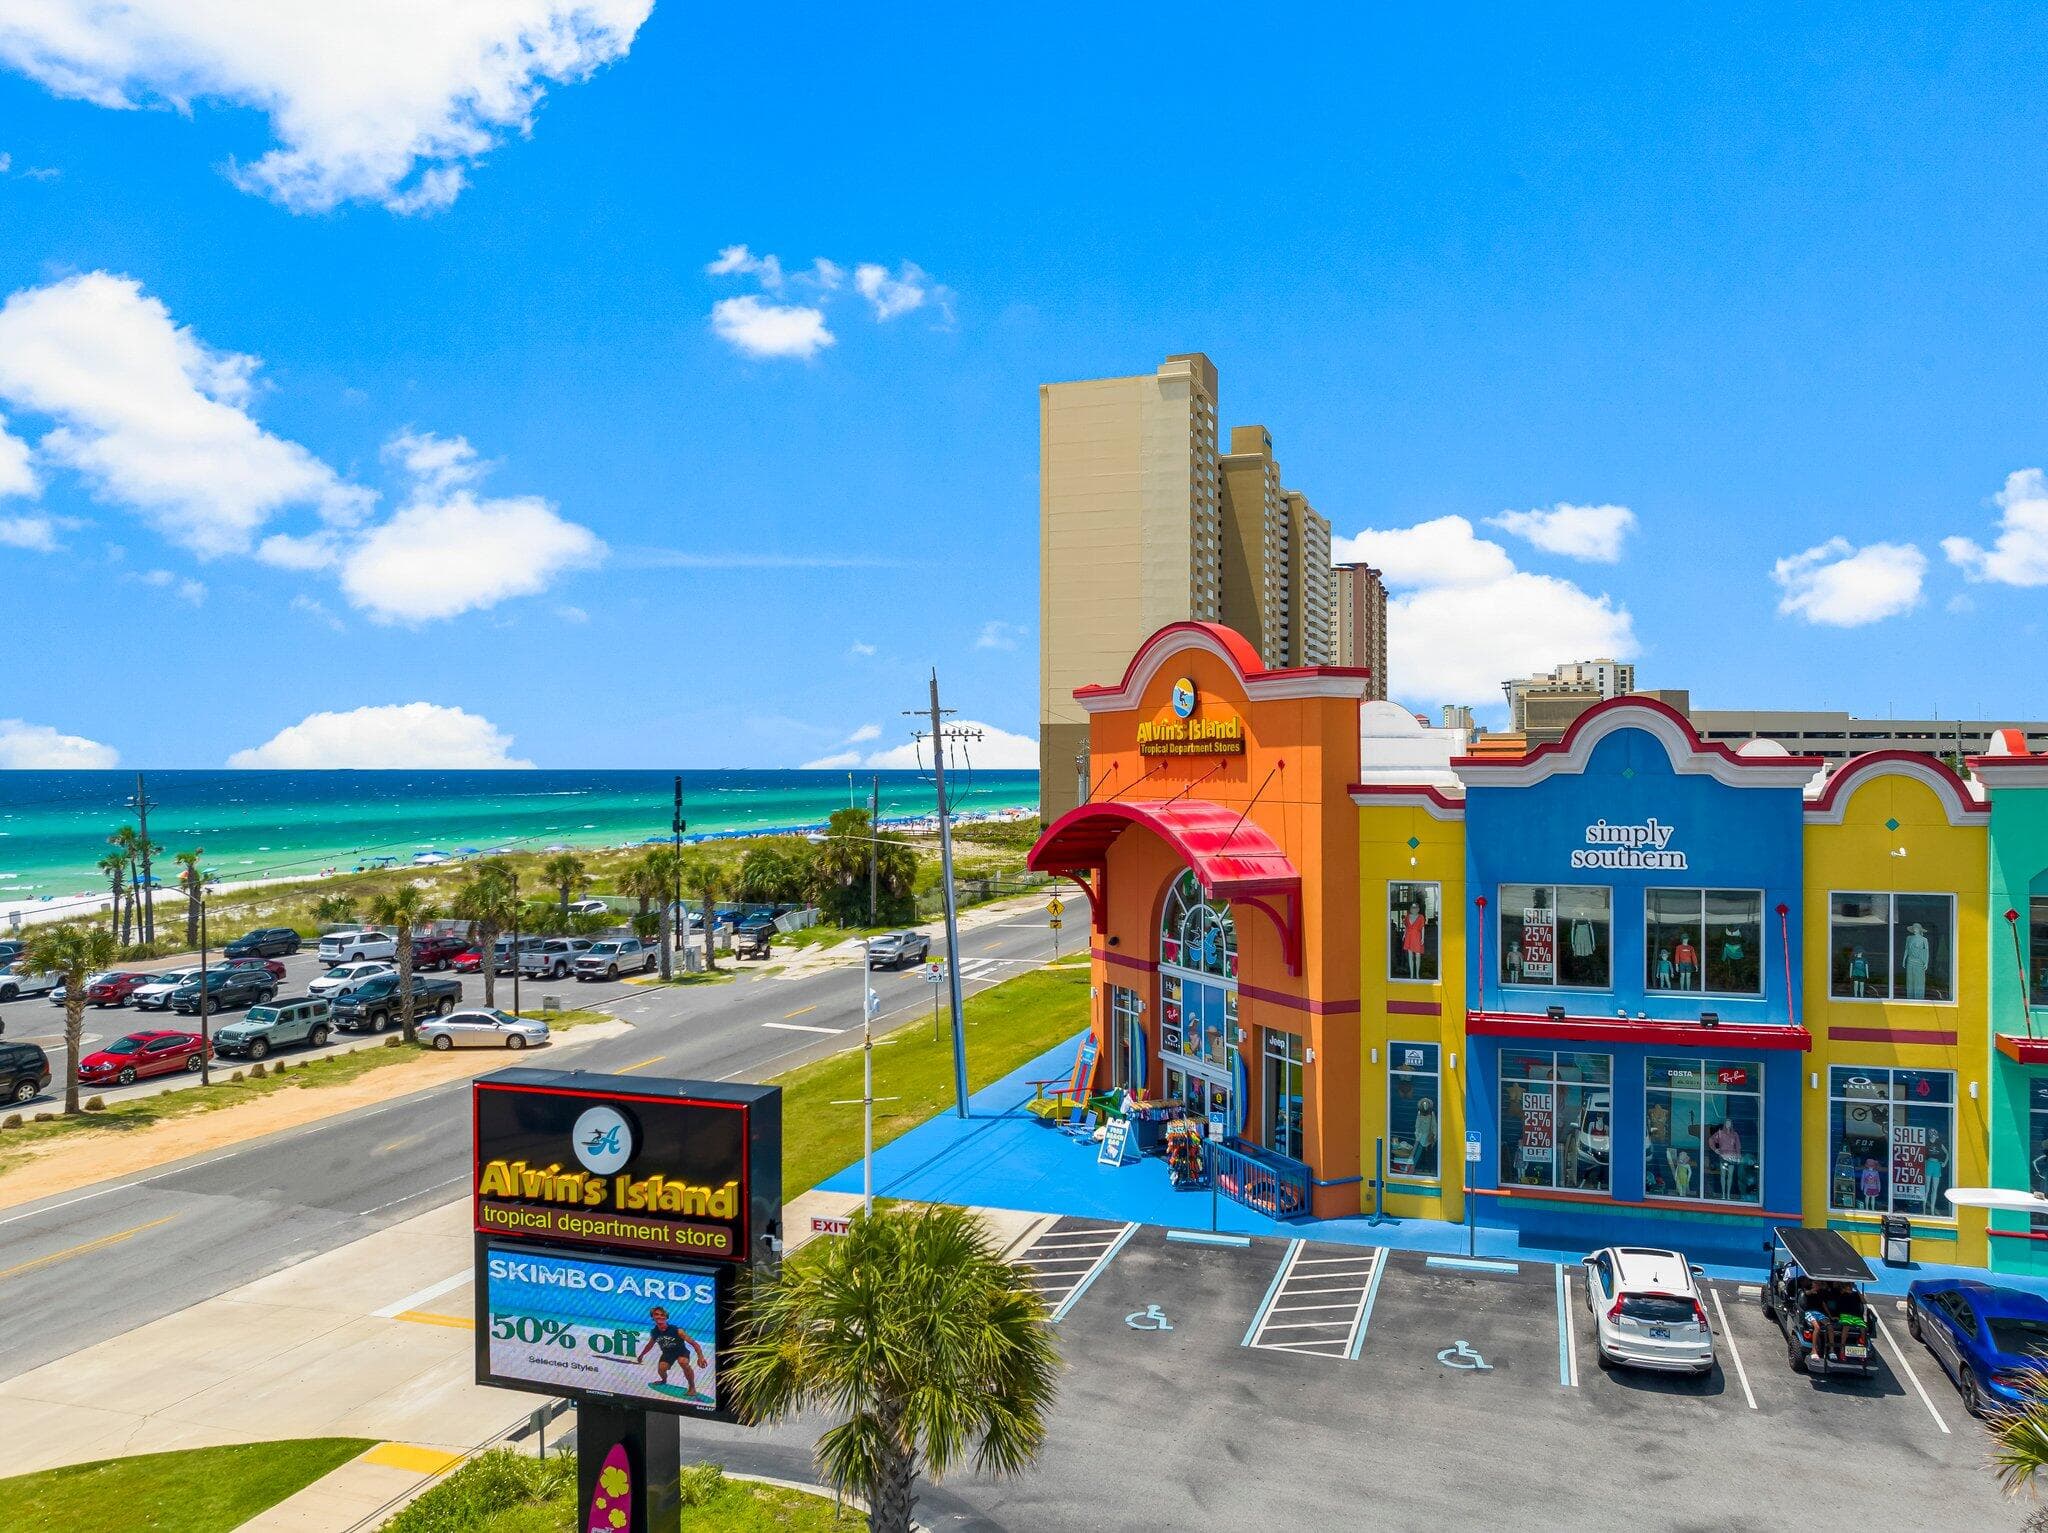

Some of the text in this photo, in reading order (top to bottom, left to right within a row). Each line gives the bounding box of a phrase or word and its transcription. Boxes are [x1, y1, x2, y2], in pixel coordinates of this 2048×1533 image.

[1137, 717, 1241, 742] Alvin's Island
[1141, 741, 1240, 755] Tropical Department Stores
[1586, 818, 1673, 849] simply
[1572, 846, 1687, 870] southern
[1525, 909, 1552, 925] SALE
[1525, 926, 1552, 942] 25%
[1525, 947, 1552, 962] 75%
[1269, 1035, 1286, 1050] Jeep
[1667, 1070, 1693, 1078] COSTA
[1524, 1095, 1551, 1109] SALE
[1524, 1111, 1551, 1127] 25%
[1524, 1131, 1551, 1147] 75%
[1894, 1127, 1924, 1144] SALE
[1527, 1148, 1548, 1156] OFF
[1894, 1145, 1924, 1162] 25%
[1894, 1166, 1924, 1183] 75%
[479, 1161, 739, 1220] Alvin's Island
[1896, 1185, 1921, 1193] OFF
[484, 1205, 727, 1248] tropical department store
[813, 1220, 849, 1234] EXIT
[489, 1259, 713, 1304] SKIMBOARDS
[491, 1312, 640, 1357] 50% off
[528, 1355, 599, 1374] Selected Styles
